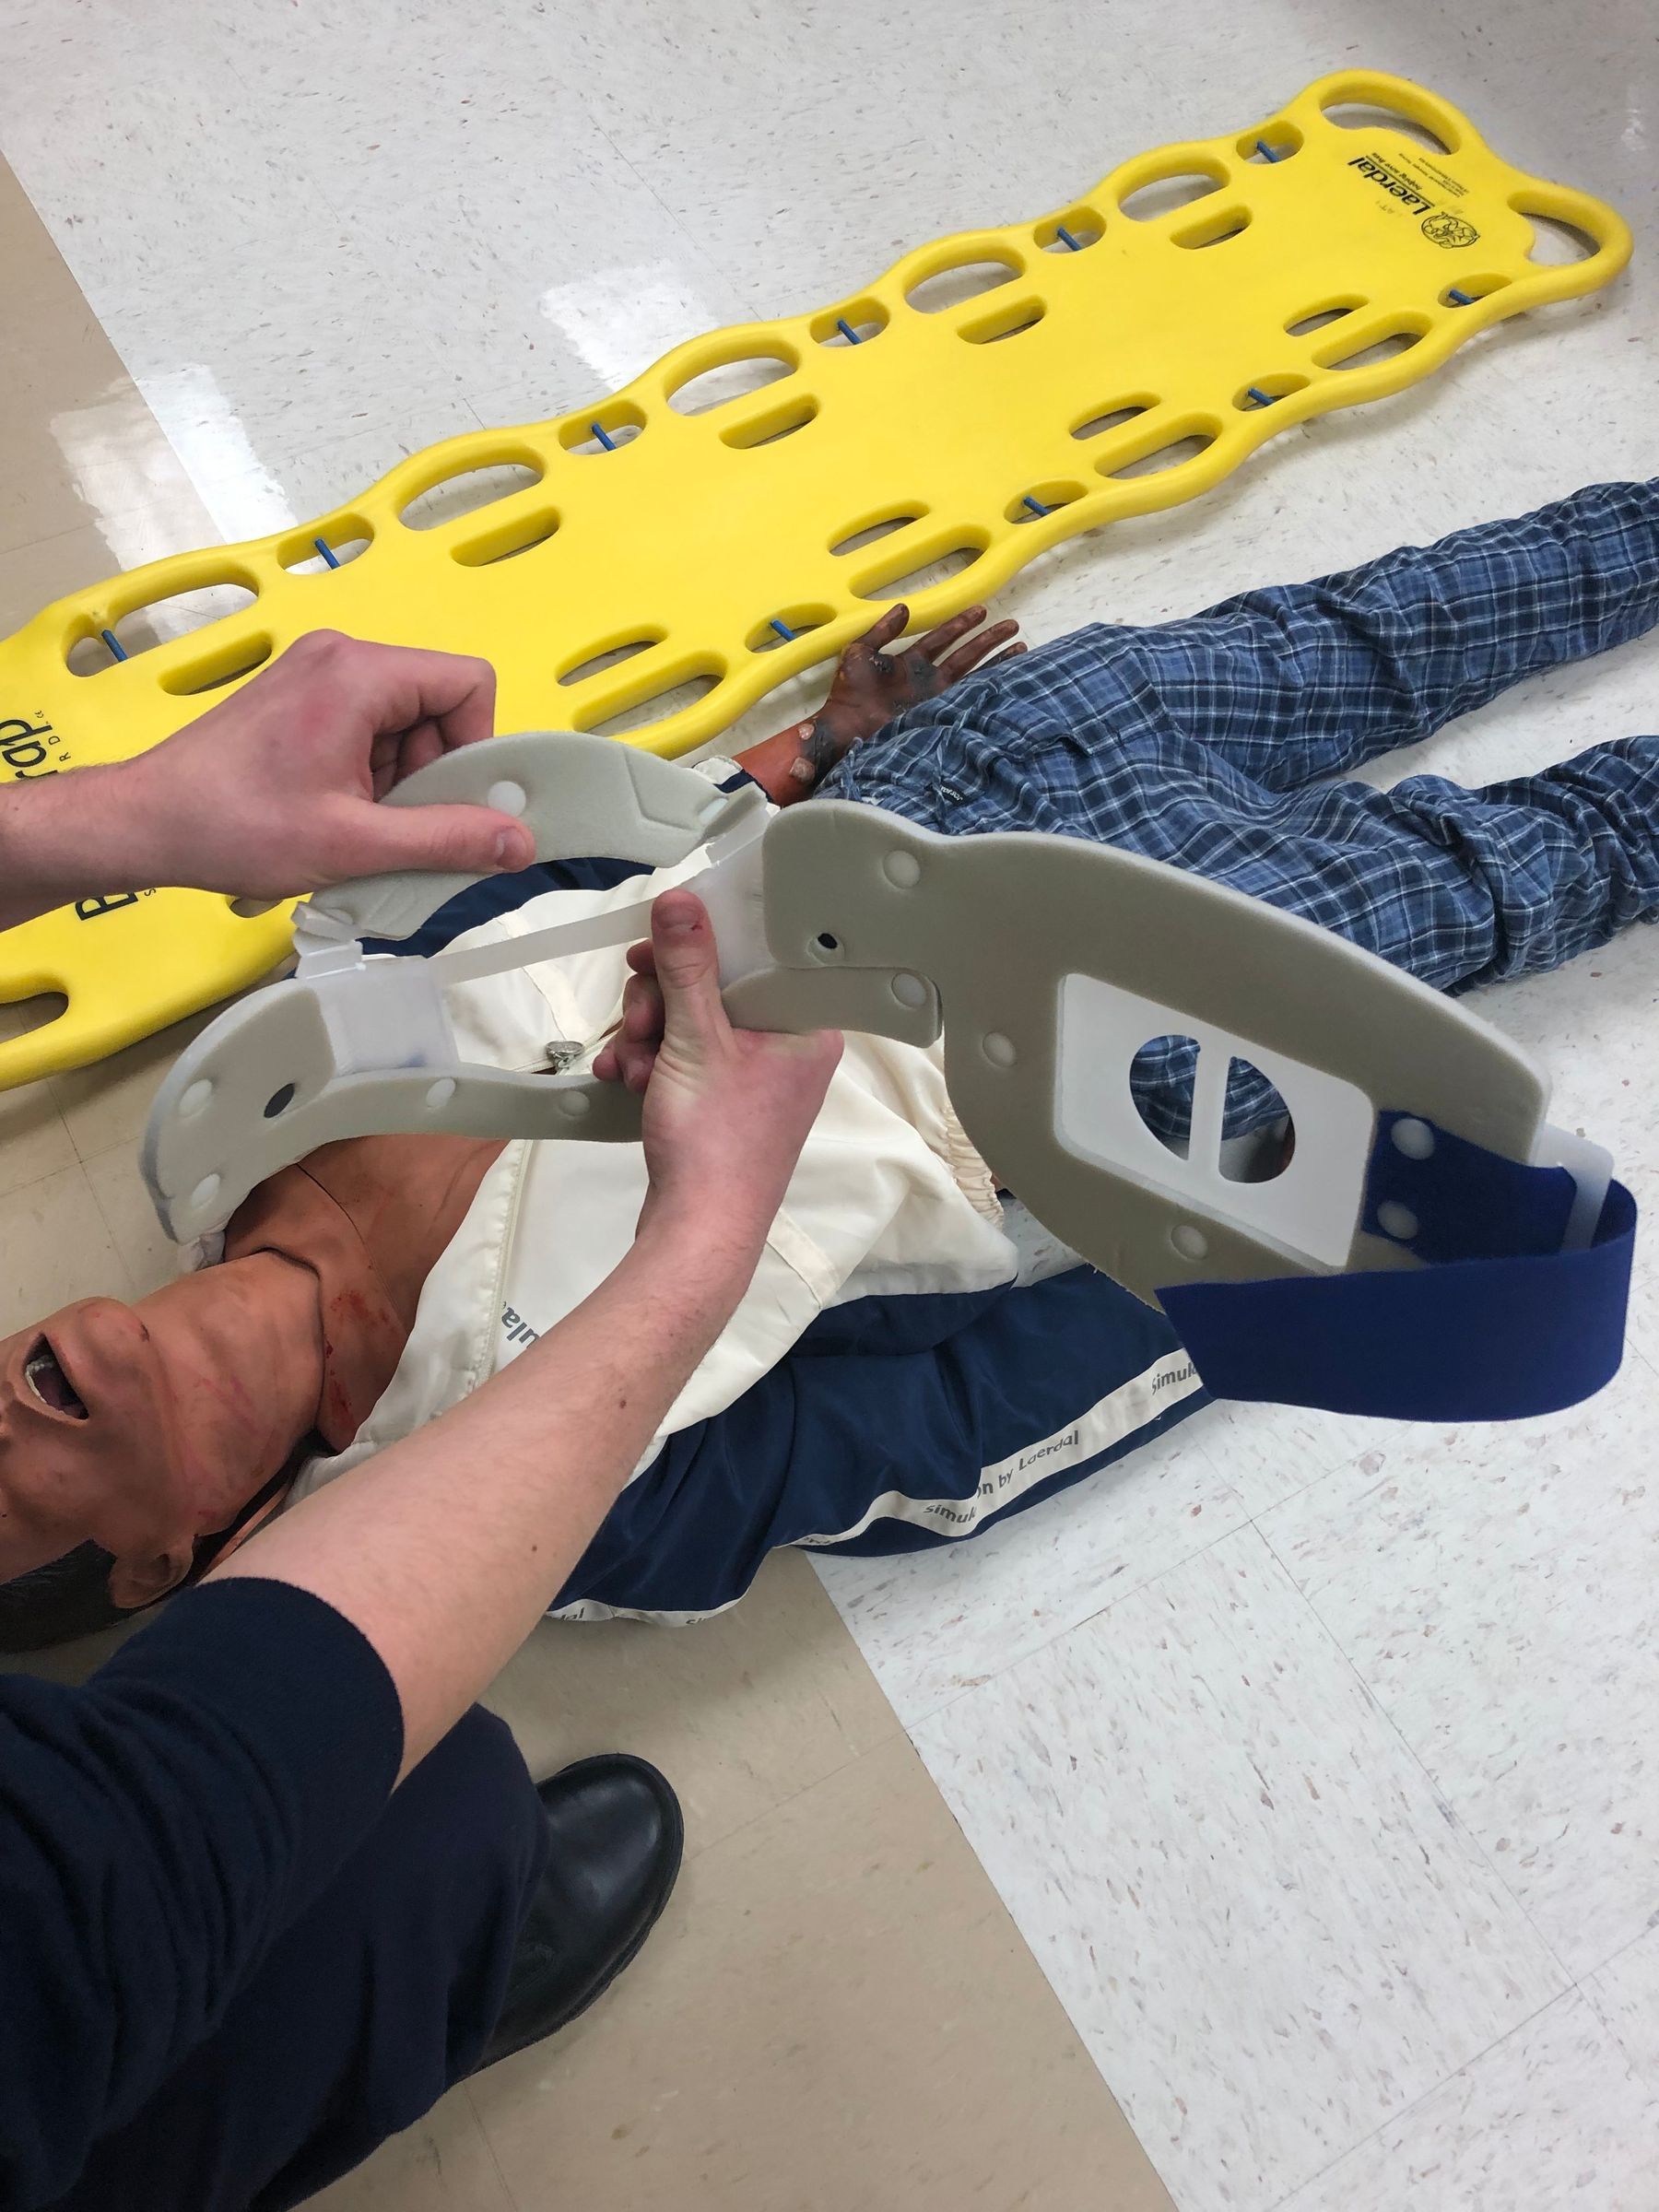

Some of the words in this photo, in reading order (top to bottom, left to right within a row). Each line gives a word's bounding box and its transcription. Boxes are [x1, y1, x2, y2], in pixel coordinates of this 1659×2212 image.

[1347, 157, 1430, 215] Laerdal
[998, 1468, 1014, 1488] by
[1018, 1430, 1079, 1470] Laerdal
[923, 1504, 976, 1524] simul
